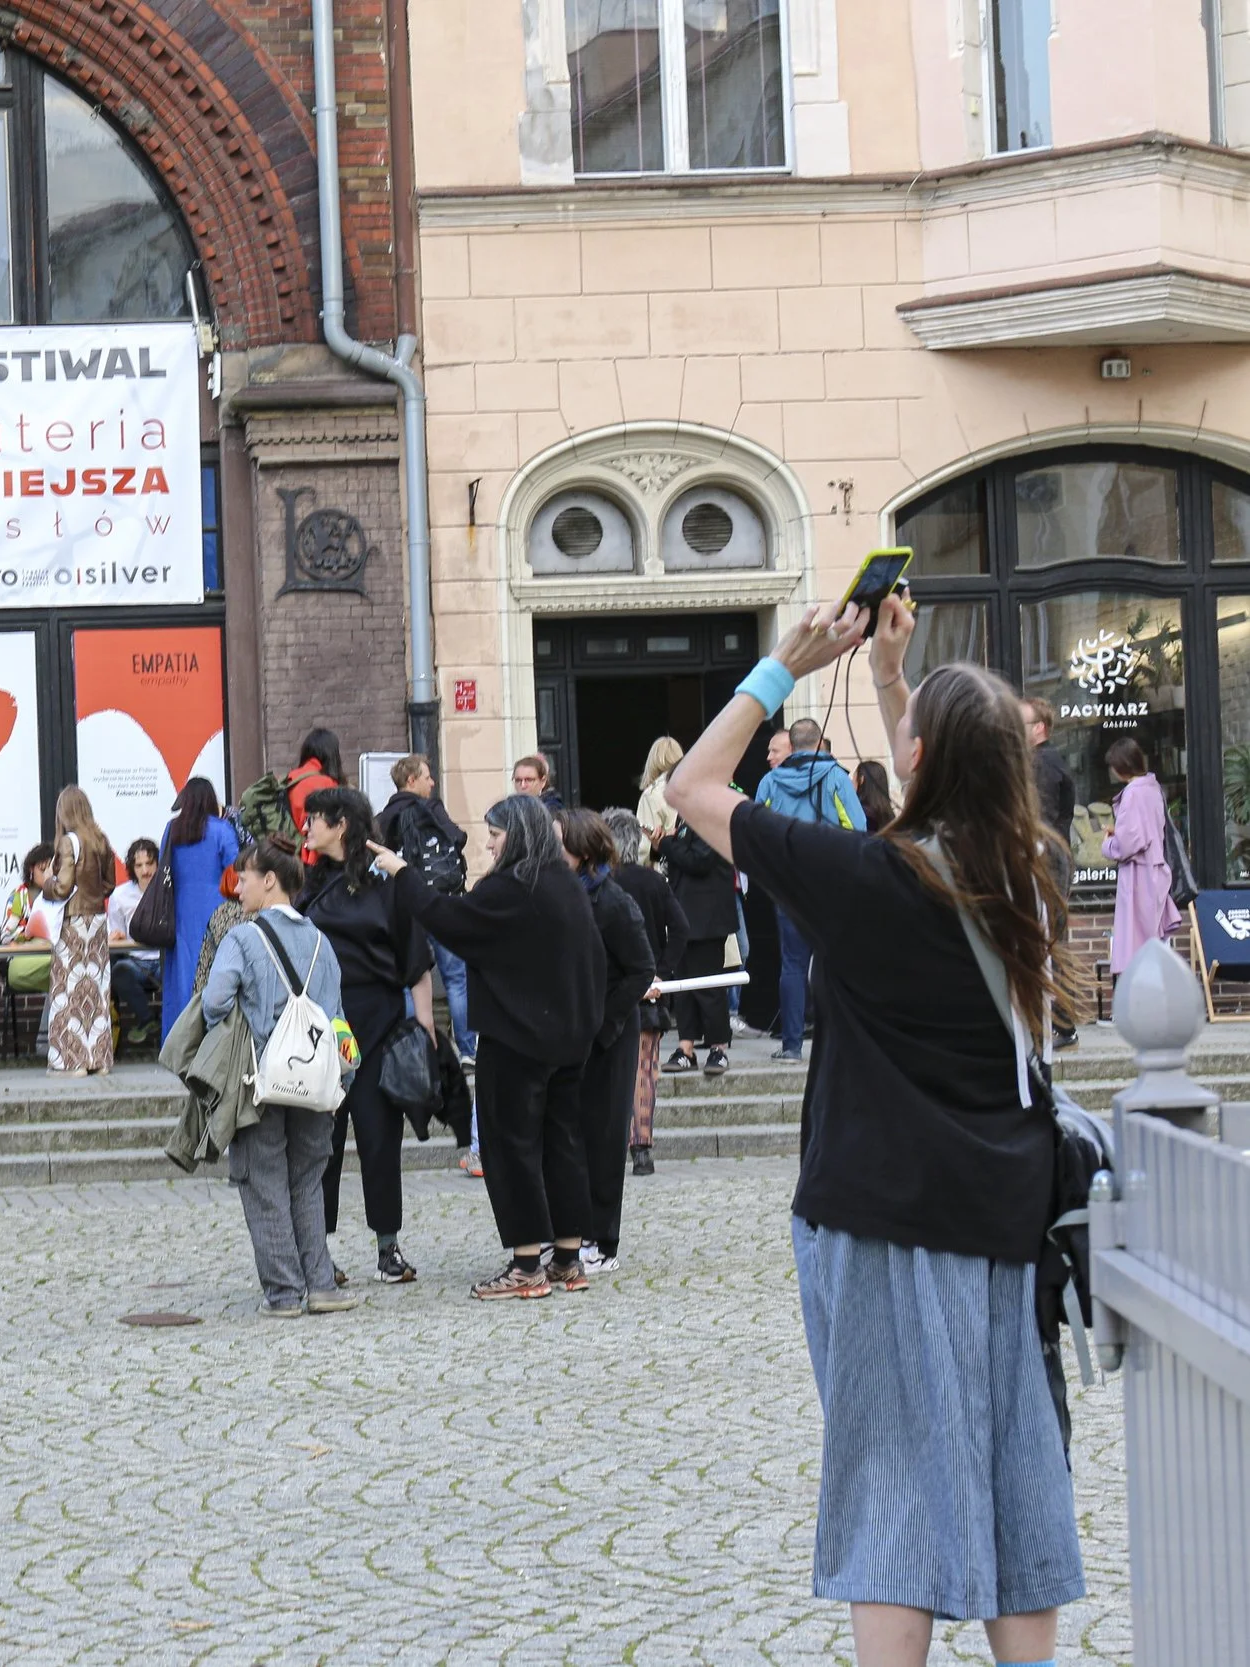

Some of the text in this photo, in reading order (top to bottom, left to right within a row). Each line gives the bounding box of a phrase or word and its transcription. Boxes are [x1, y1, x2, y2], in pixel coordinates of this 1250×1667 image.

[6, 510, 171, 540] słów
[132, 652, 199, 674] EMPATIA
[140, 675, 189, 688] empathy
[1060, 702, 1149, 718] PACYKARZ
[1102, 720, 1138, 729] GALERIA
[1072, 867, 1117, 884] galeria
